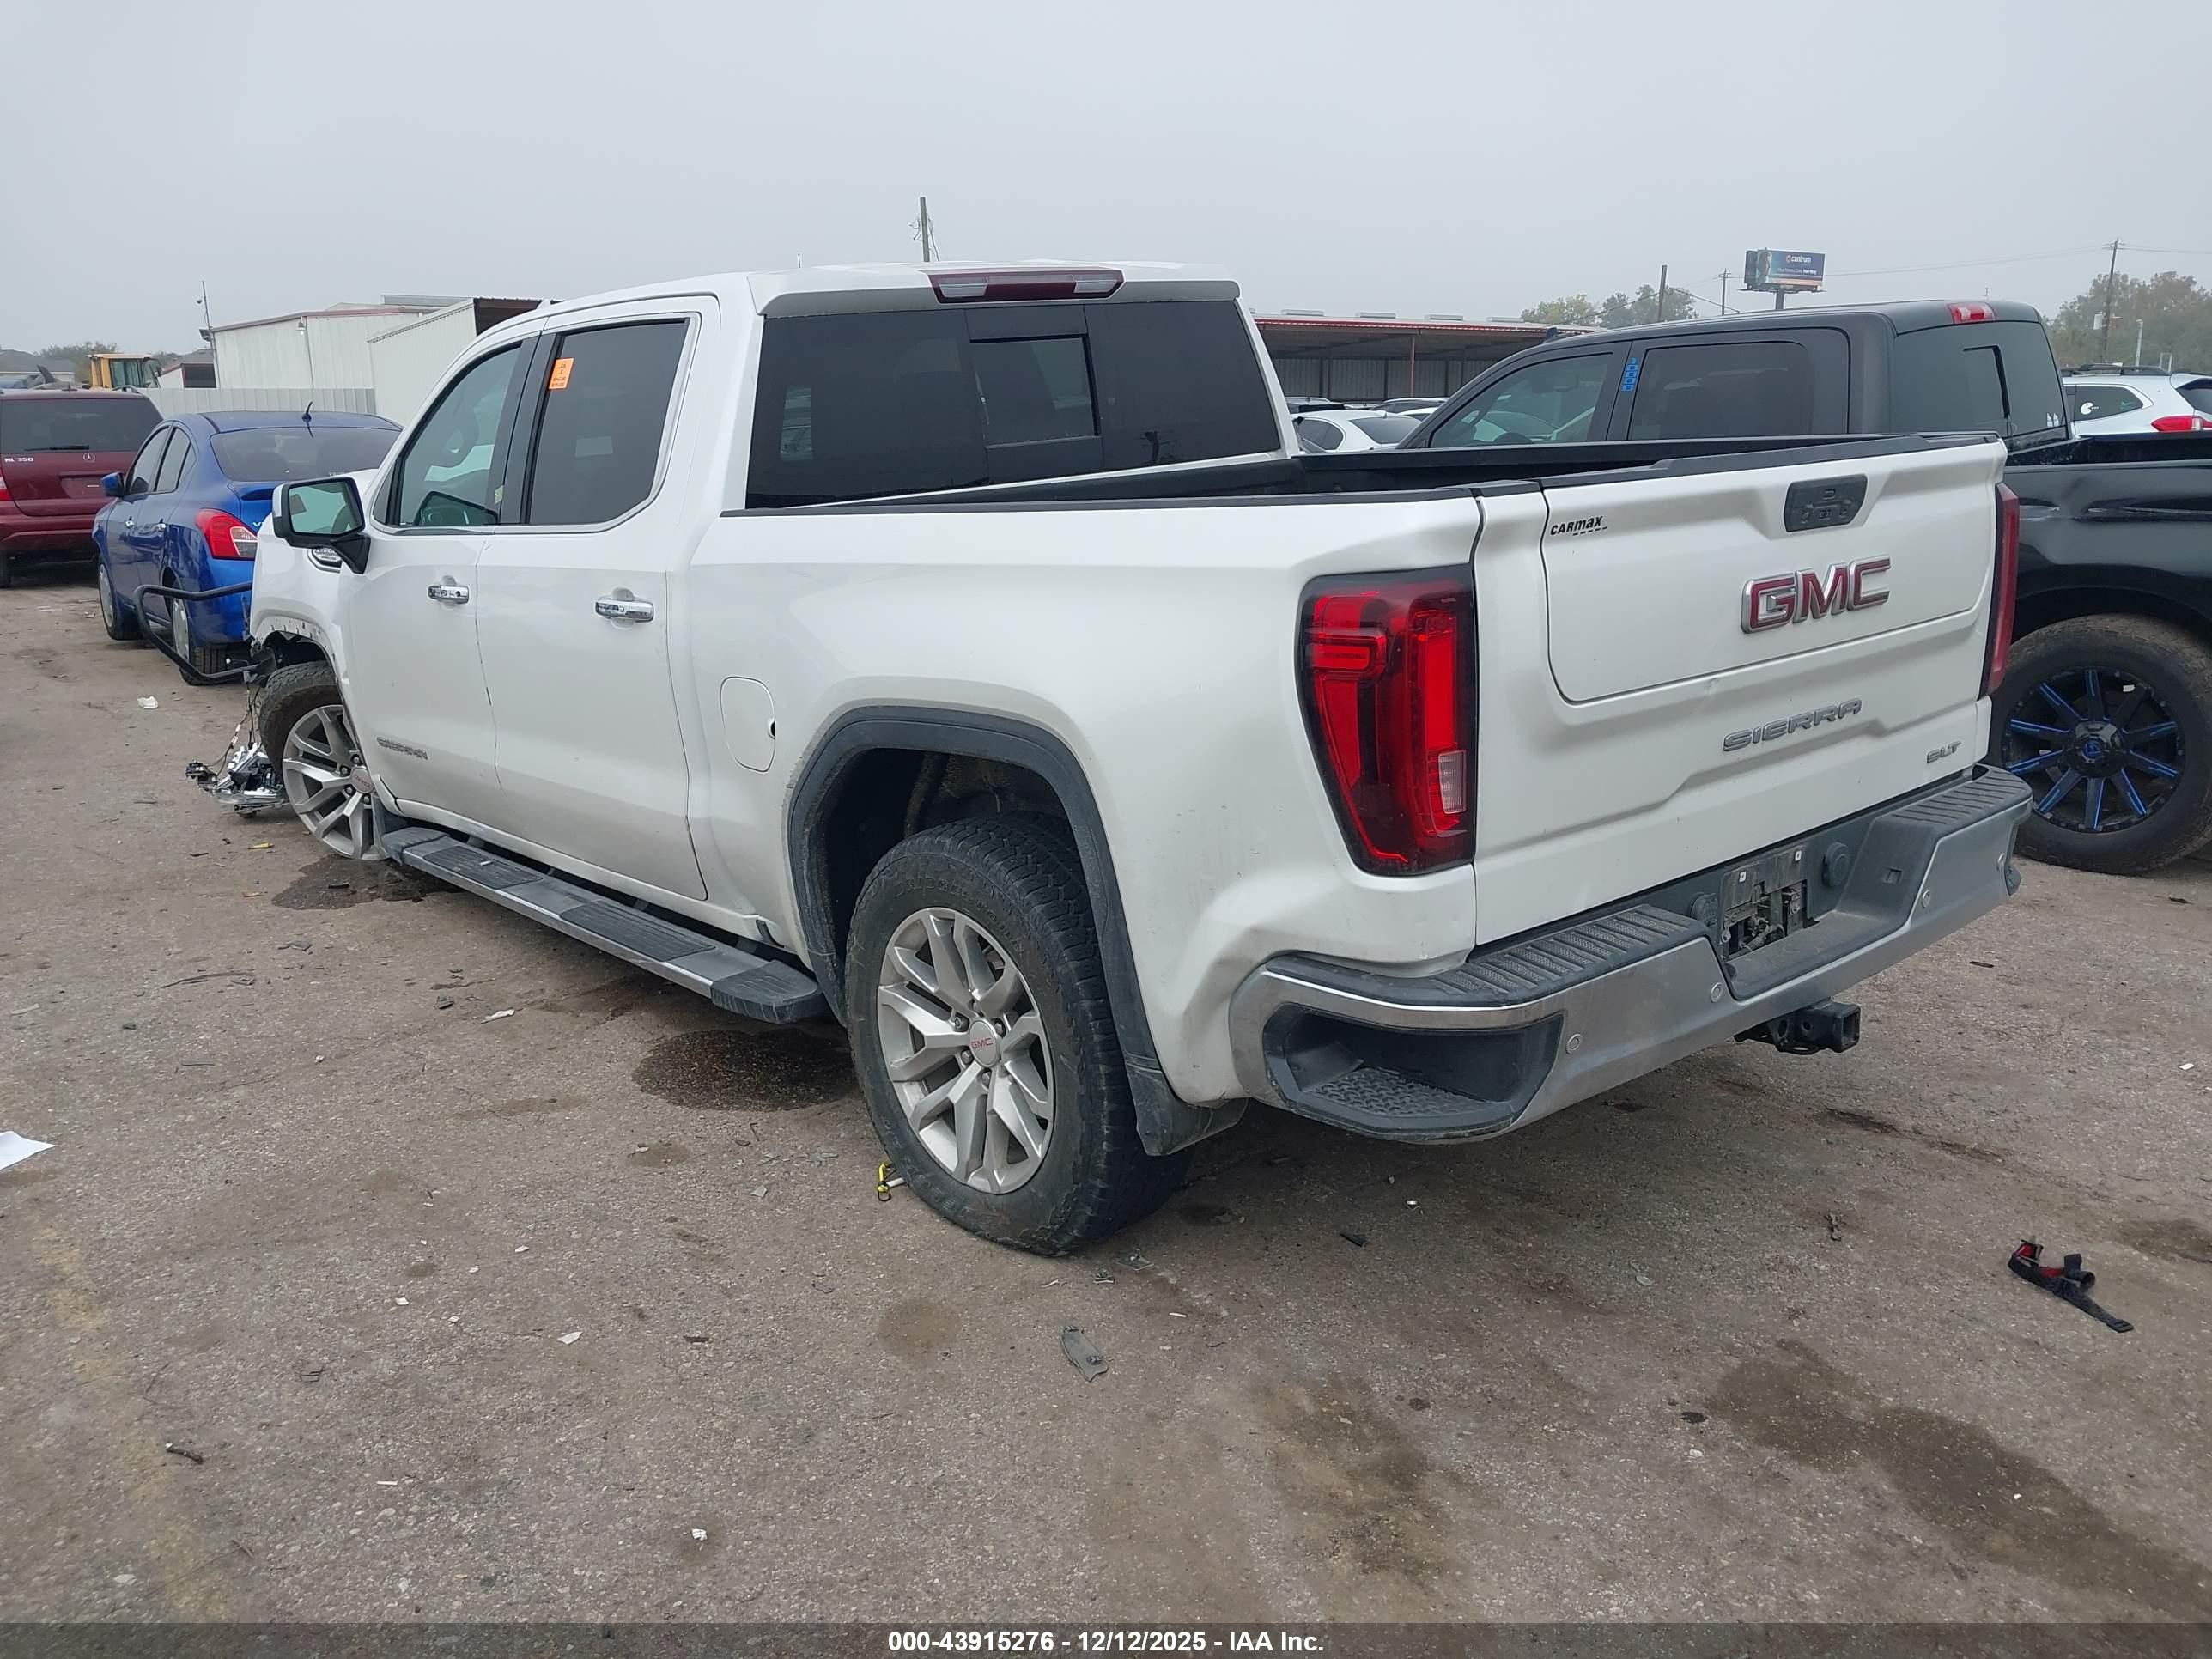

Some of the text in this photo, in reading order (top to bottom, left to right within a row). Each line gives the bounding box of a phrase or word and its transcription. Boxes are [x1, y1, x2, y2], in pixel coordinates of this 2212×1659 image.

[1741, 553, 1891, 634] GMC
[1723, 698, 1863, 752] SIERRA
[1926, 740, 1962, 764] SLT
[971, 1037, 994, 1049] GMC
